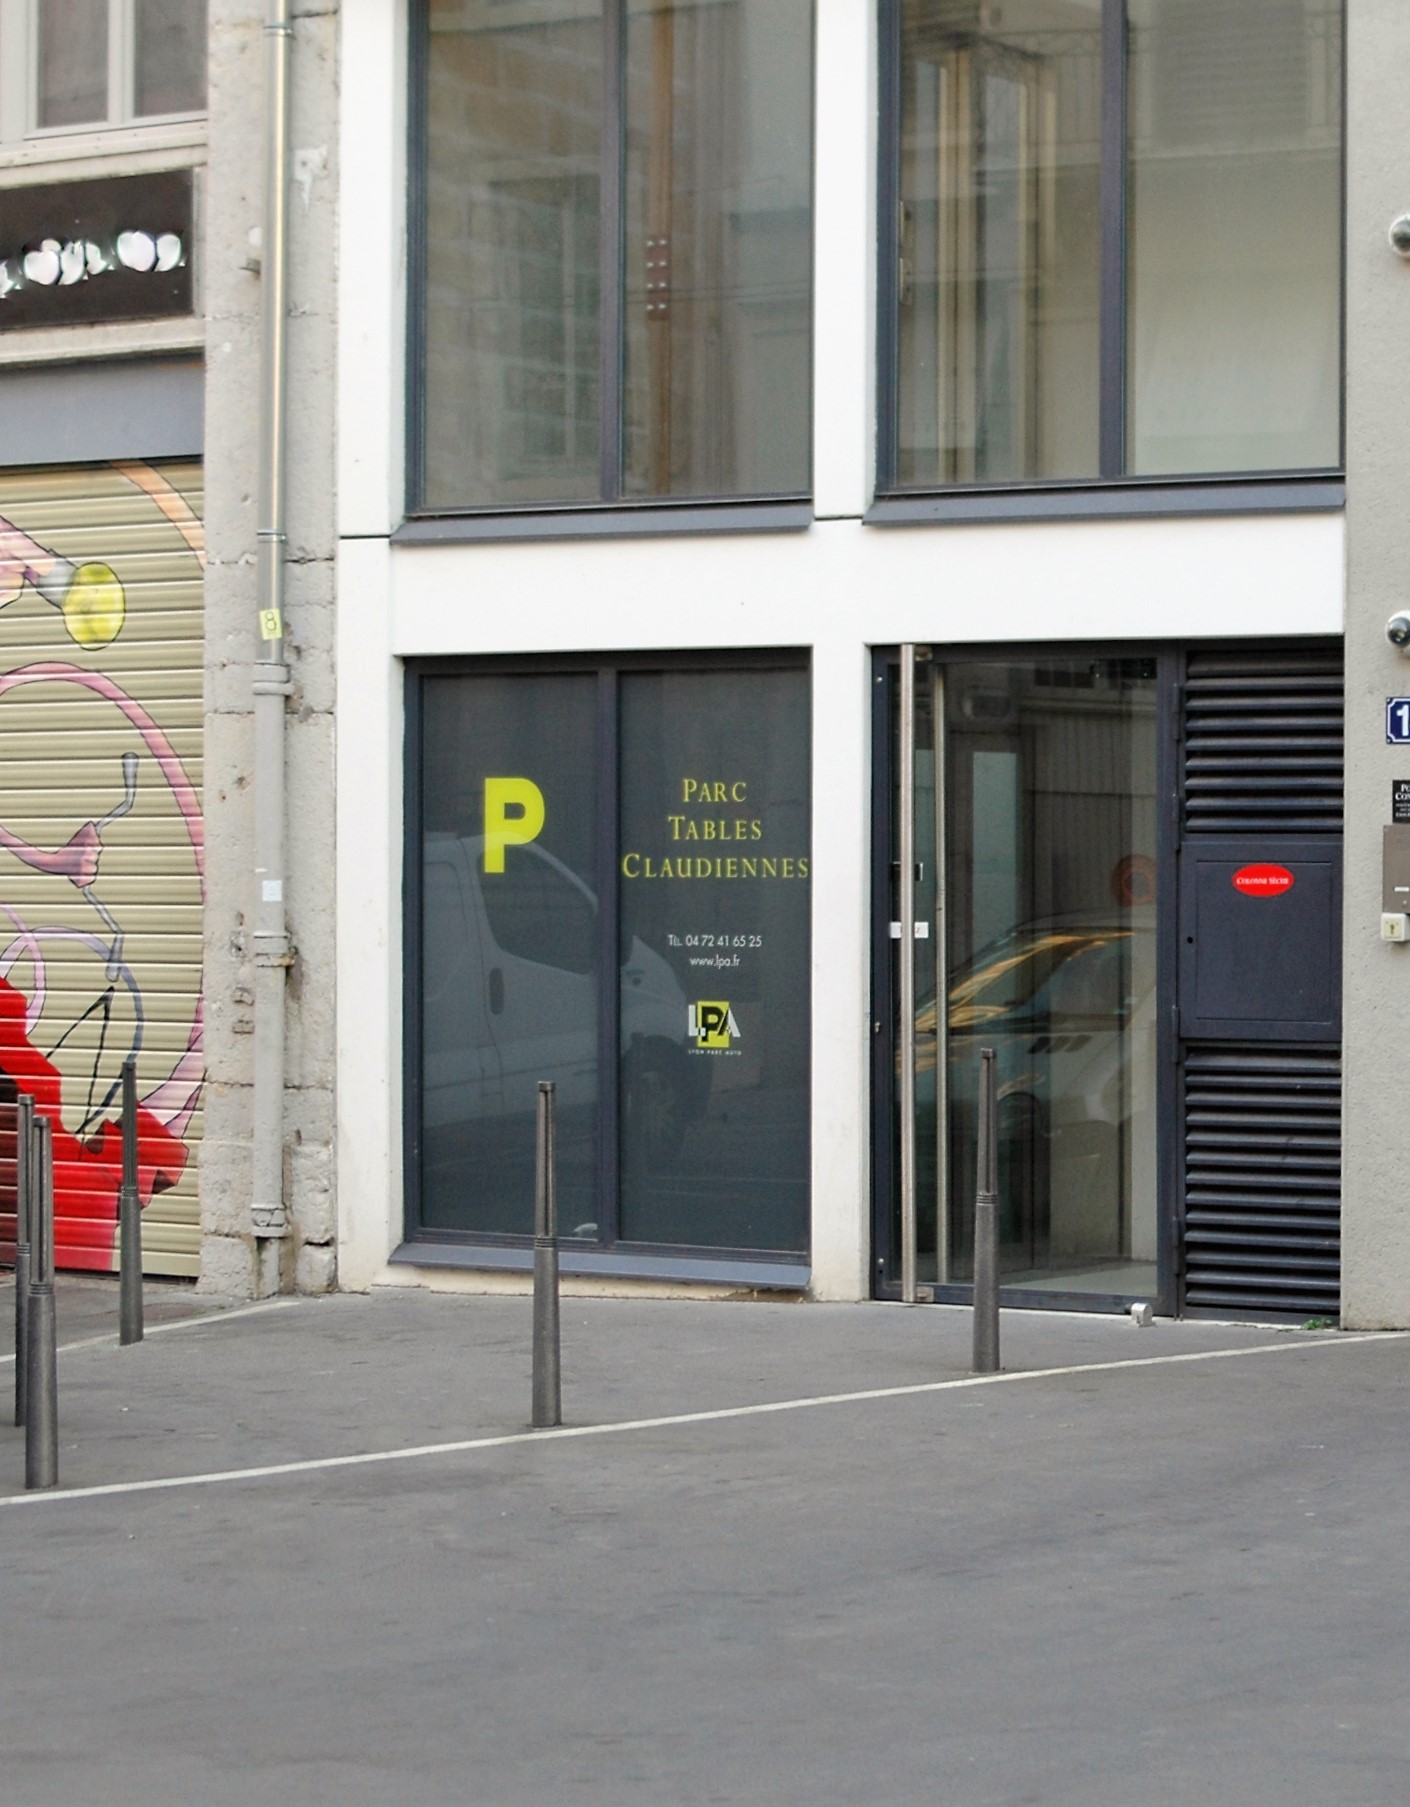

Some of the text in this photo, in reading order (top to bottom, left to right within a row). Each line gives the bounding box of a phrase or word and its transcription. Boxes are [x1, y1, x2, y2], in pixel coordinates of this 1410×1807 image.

[682, 778, 747, 802] PARC
[484, 778, 545, 873] P
[668, 816, 762, 840] TABLES
[622, 853, 809, 878] CLAUDIENNES
[685, 934, 700, 948] 04
[701, 935, 716, 948] 72
[717, 935, 730, 948] 41
[732, 936, 747, 948] 65
[748, 936, 762, 948] 25
[688, 954, 741, 970] www.lpa.fr
